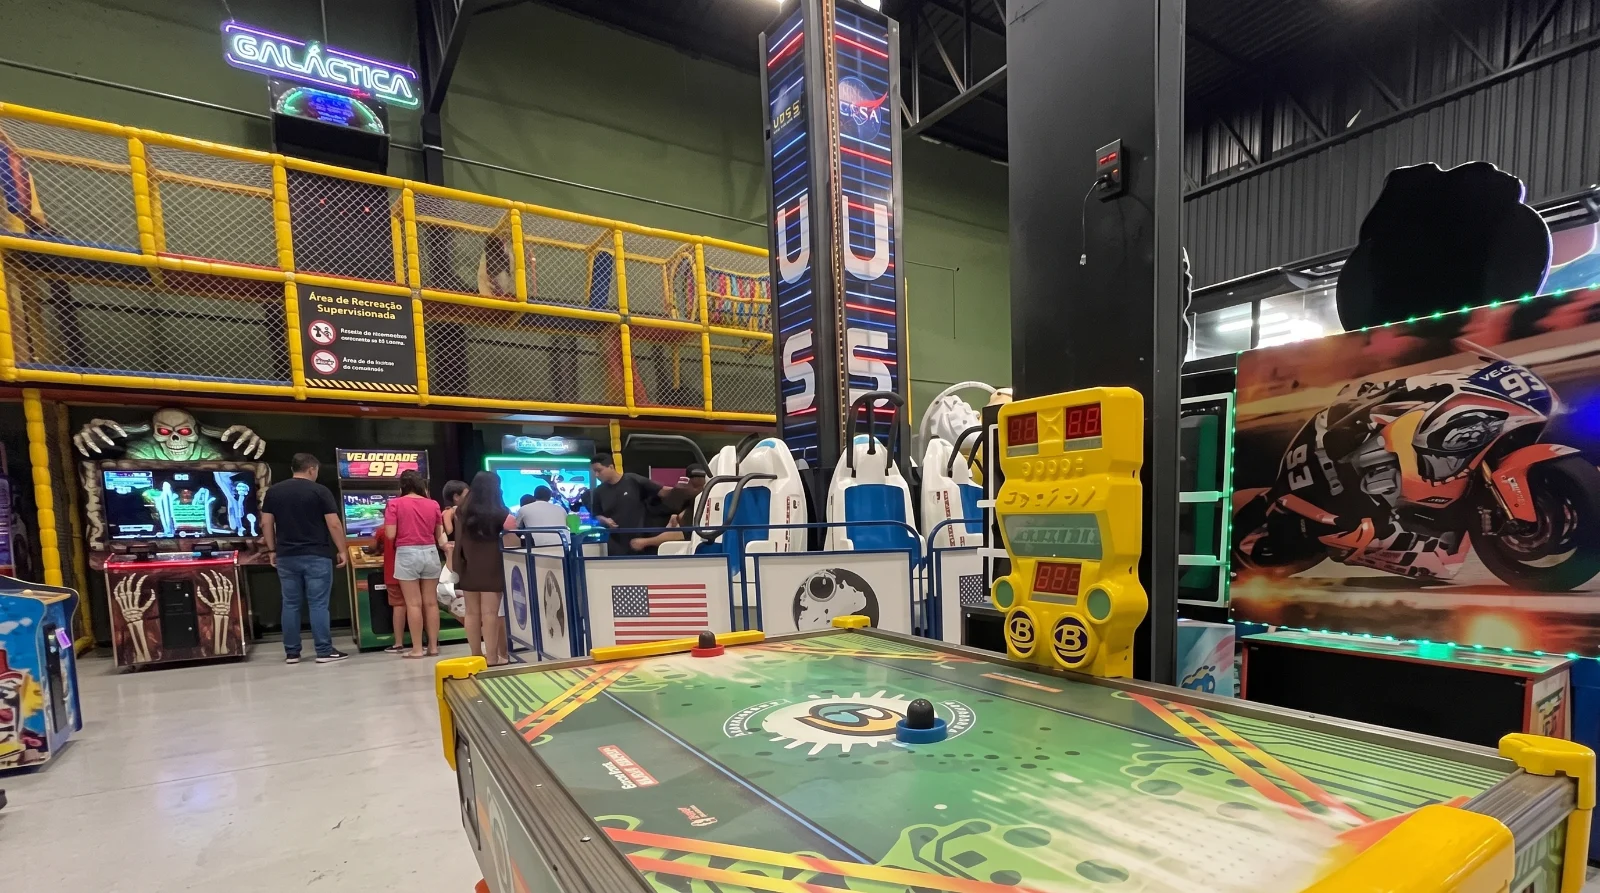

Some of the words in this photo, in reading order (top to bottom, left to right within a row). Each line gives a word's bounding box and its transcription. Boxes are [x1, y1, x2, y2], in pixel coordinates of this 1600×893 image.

[309, 291, 333, 303] Área
[336, 295, 349, 305] de
[351, 297, 403, 311] Recreação
[317, 304, 396, 320] Supervisionada
[346, 452, 418, 462] VELOCIDADE
[367, 461, 399, 477] 93
